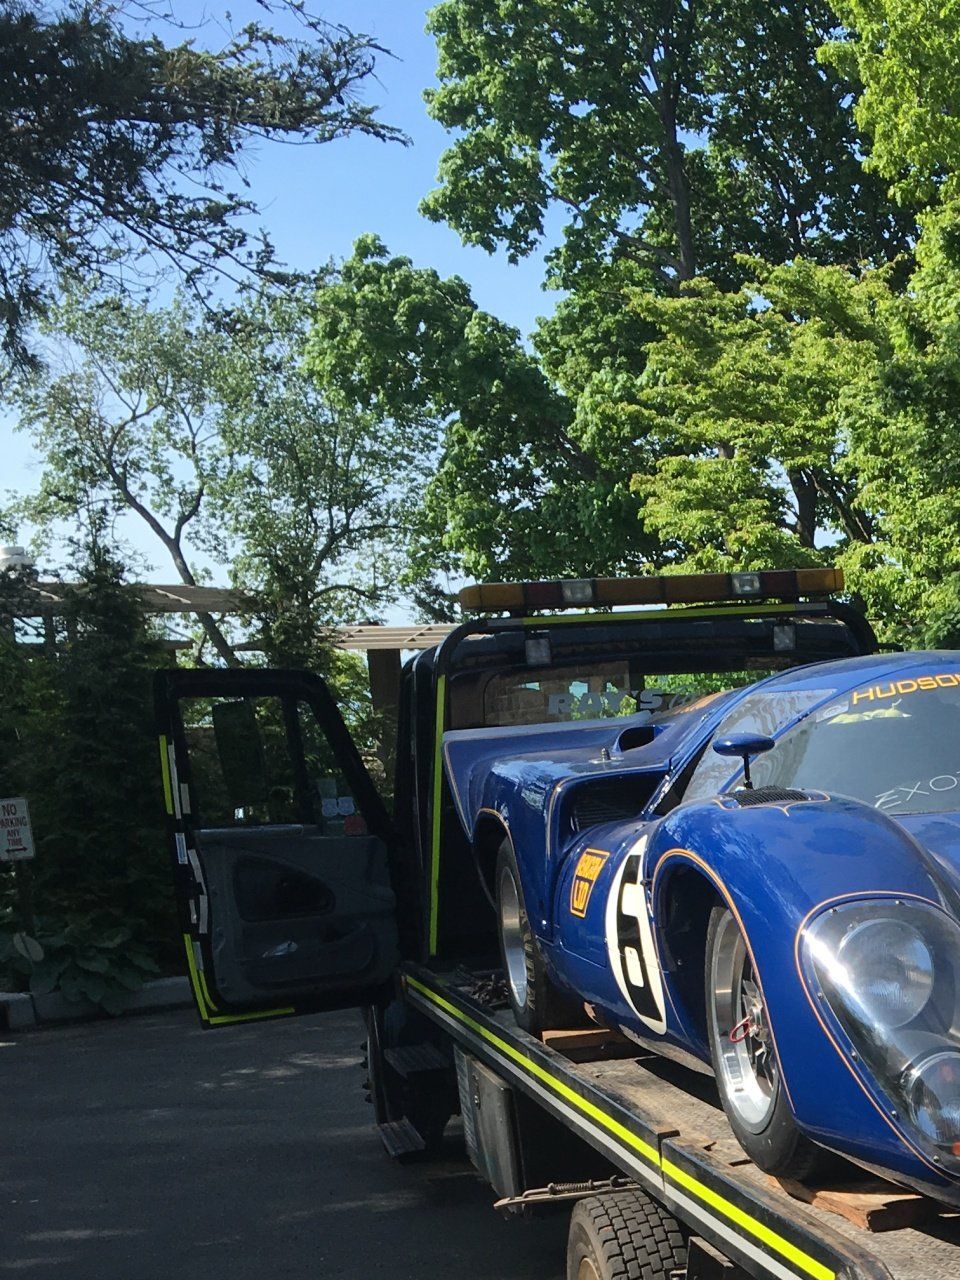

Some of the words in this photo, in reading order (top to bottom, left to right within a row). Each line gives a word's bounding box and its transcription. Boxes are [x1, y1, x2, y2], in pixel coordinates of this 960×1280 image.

[547, 688, 664, 715] RAY'S
[2, 803, 17, 816] NO
[0, 816, 28, 828] ARKING
[7, 829, 20, 838] ANY
[8, 838, 23, 847] TIME
[617, 855, 663, 1022] 6
